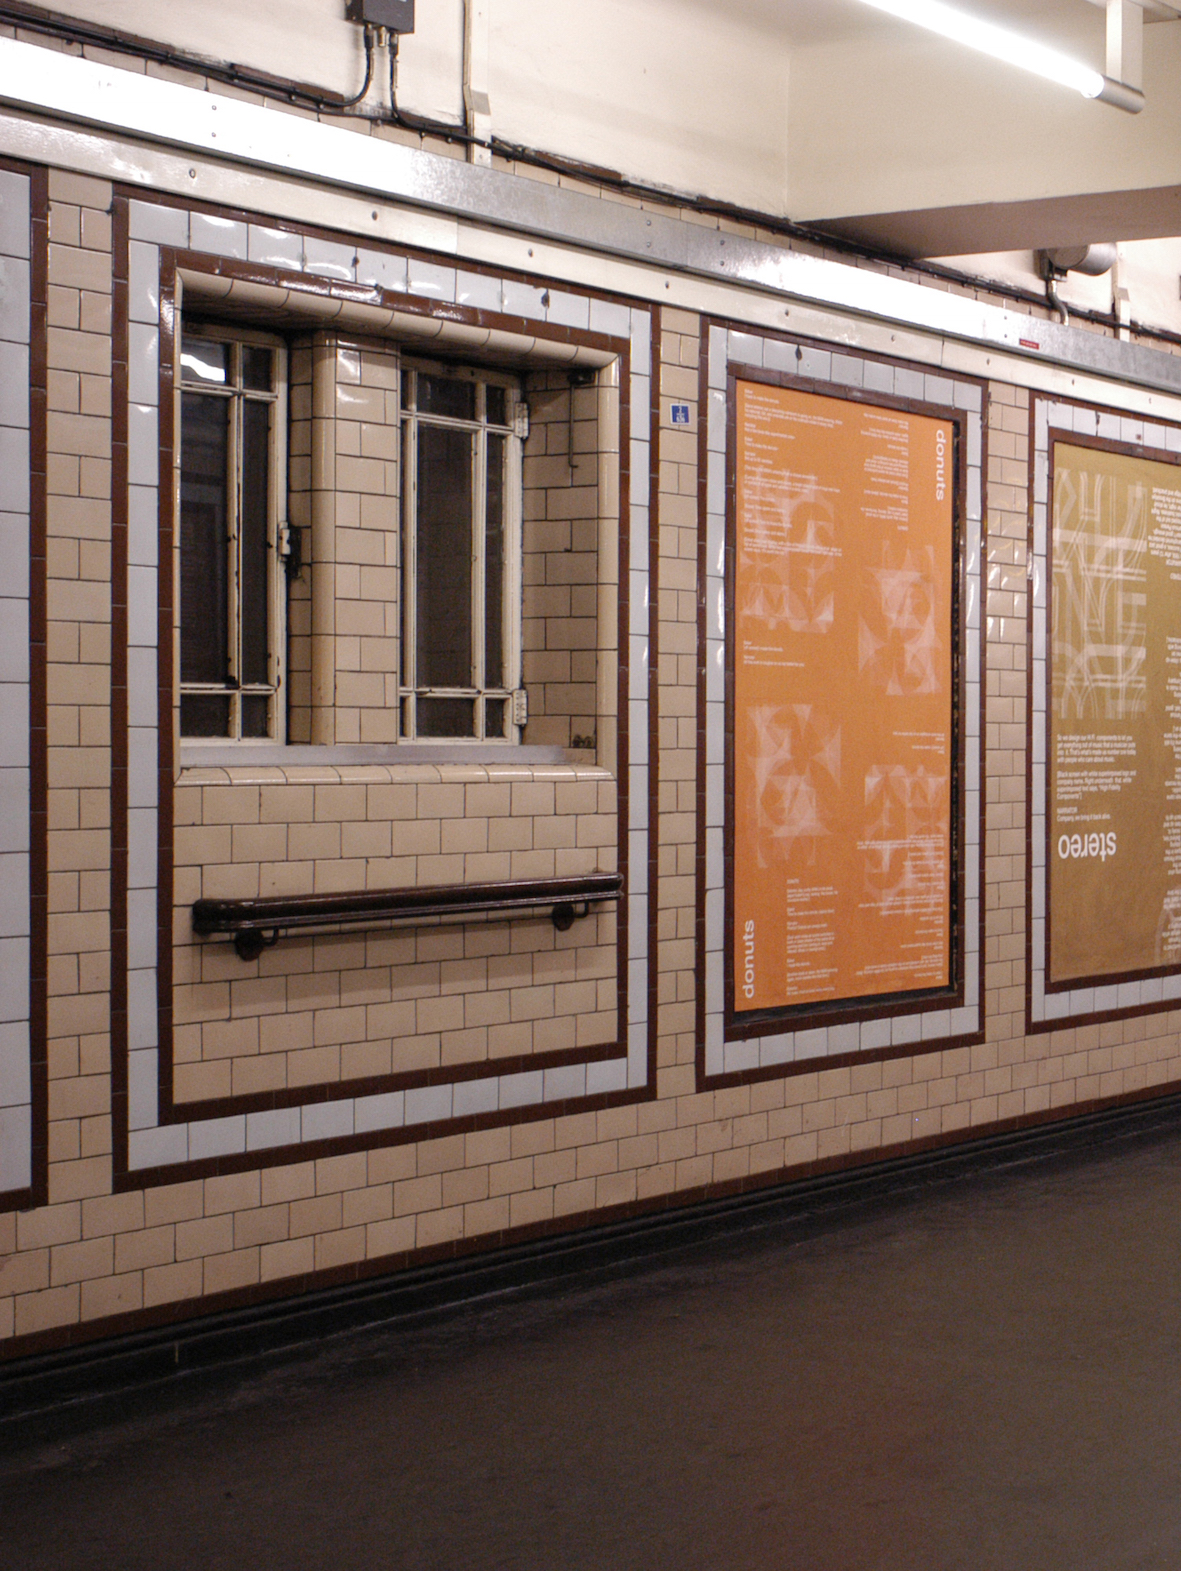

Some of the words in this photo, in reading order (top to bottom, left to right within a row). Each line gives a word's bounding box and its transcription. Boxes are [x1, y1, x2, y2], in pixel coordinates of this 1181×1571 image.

[936, 429, 946, 501] donuts
[1058, 832, 1117, 862] stereo
[742, 919, 755, 999] donuts
